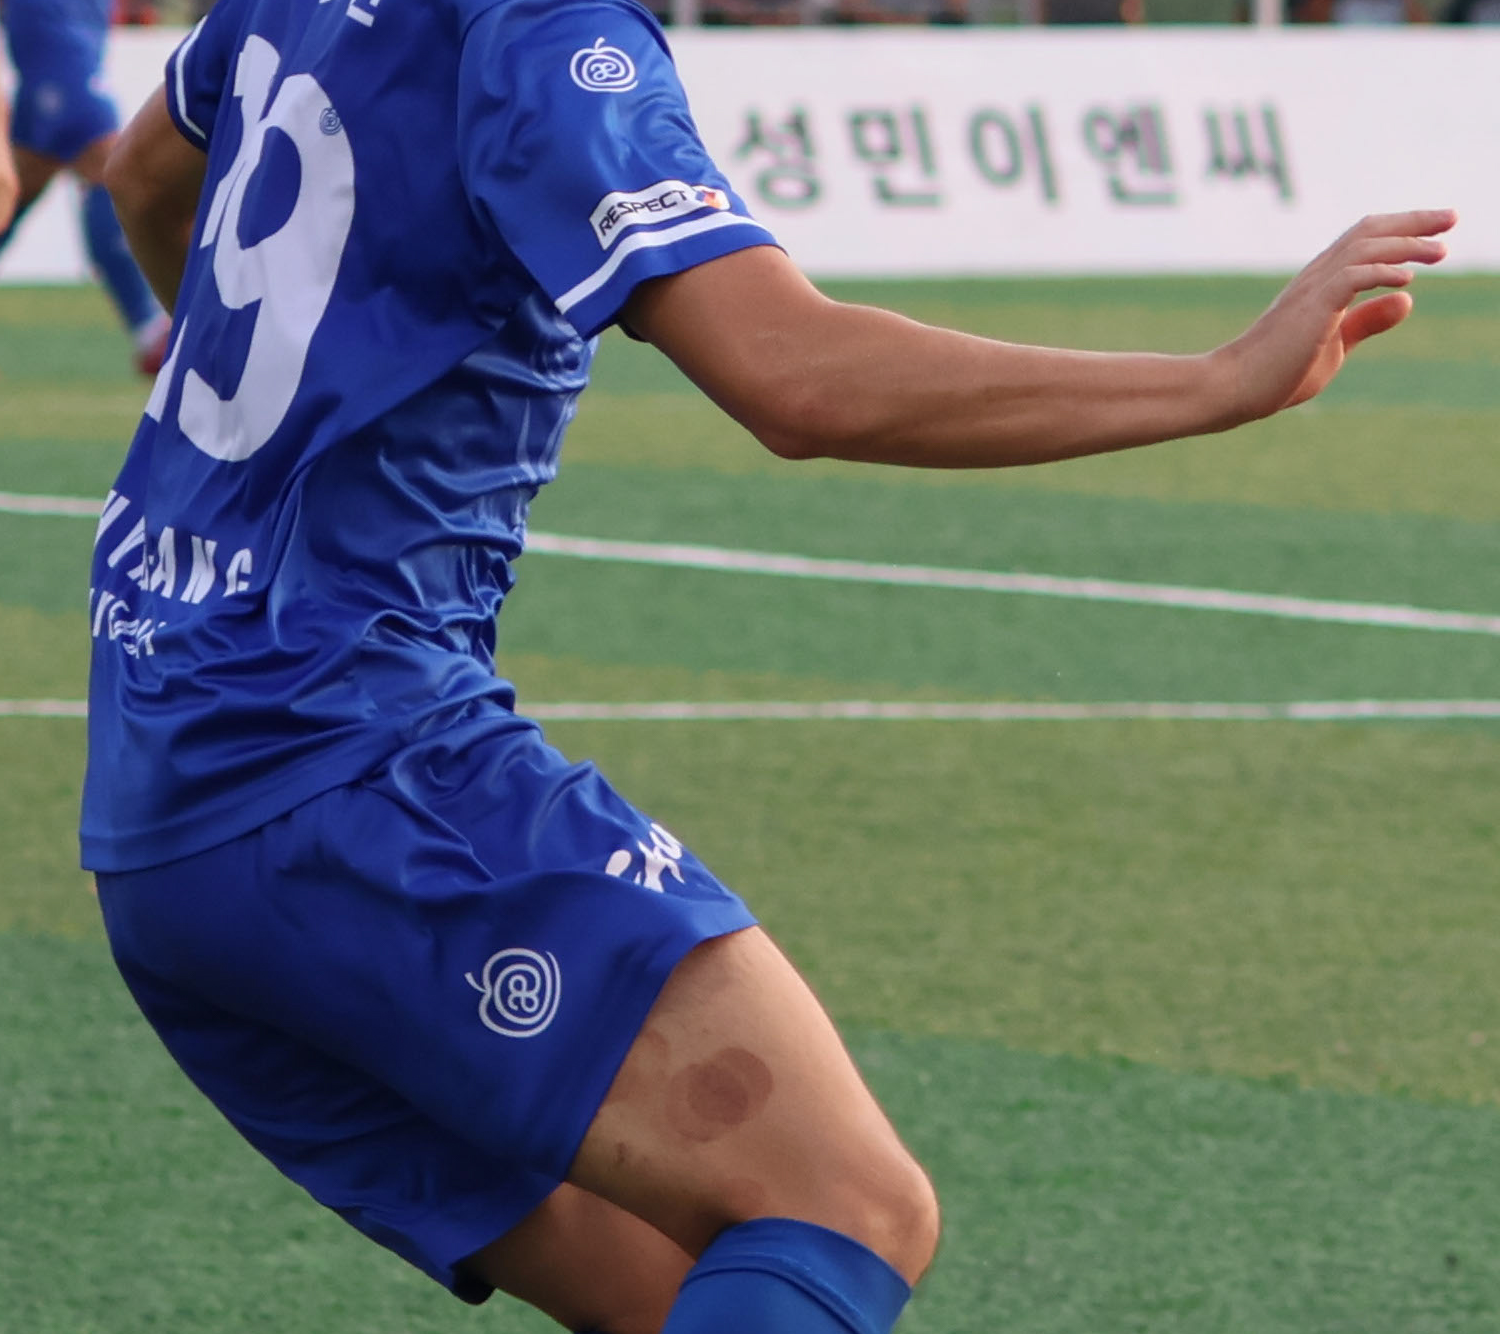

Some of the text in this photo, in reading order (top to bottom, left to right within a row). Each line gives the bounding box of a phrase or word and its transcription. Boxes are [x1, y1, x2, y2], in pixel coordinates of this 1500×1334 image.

[733, 102, 1296, 209] 성민이엔씨
[144, 33, 356, 463] 19
[597, 189, 689, 238] RESPECT
